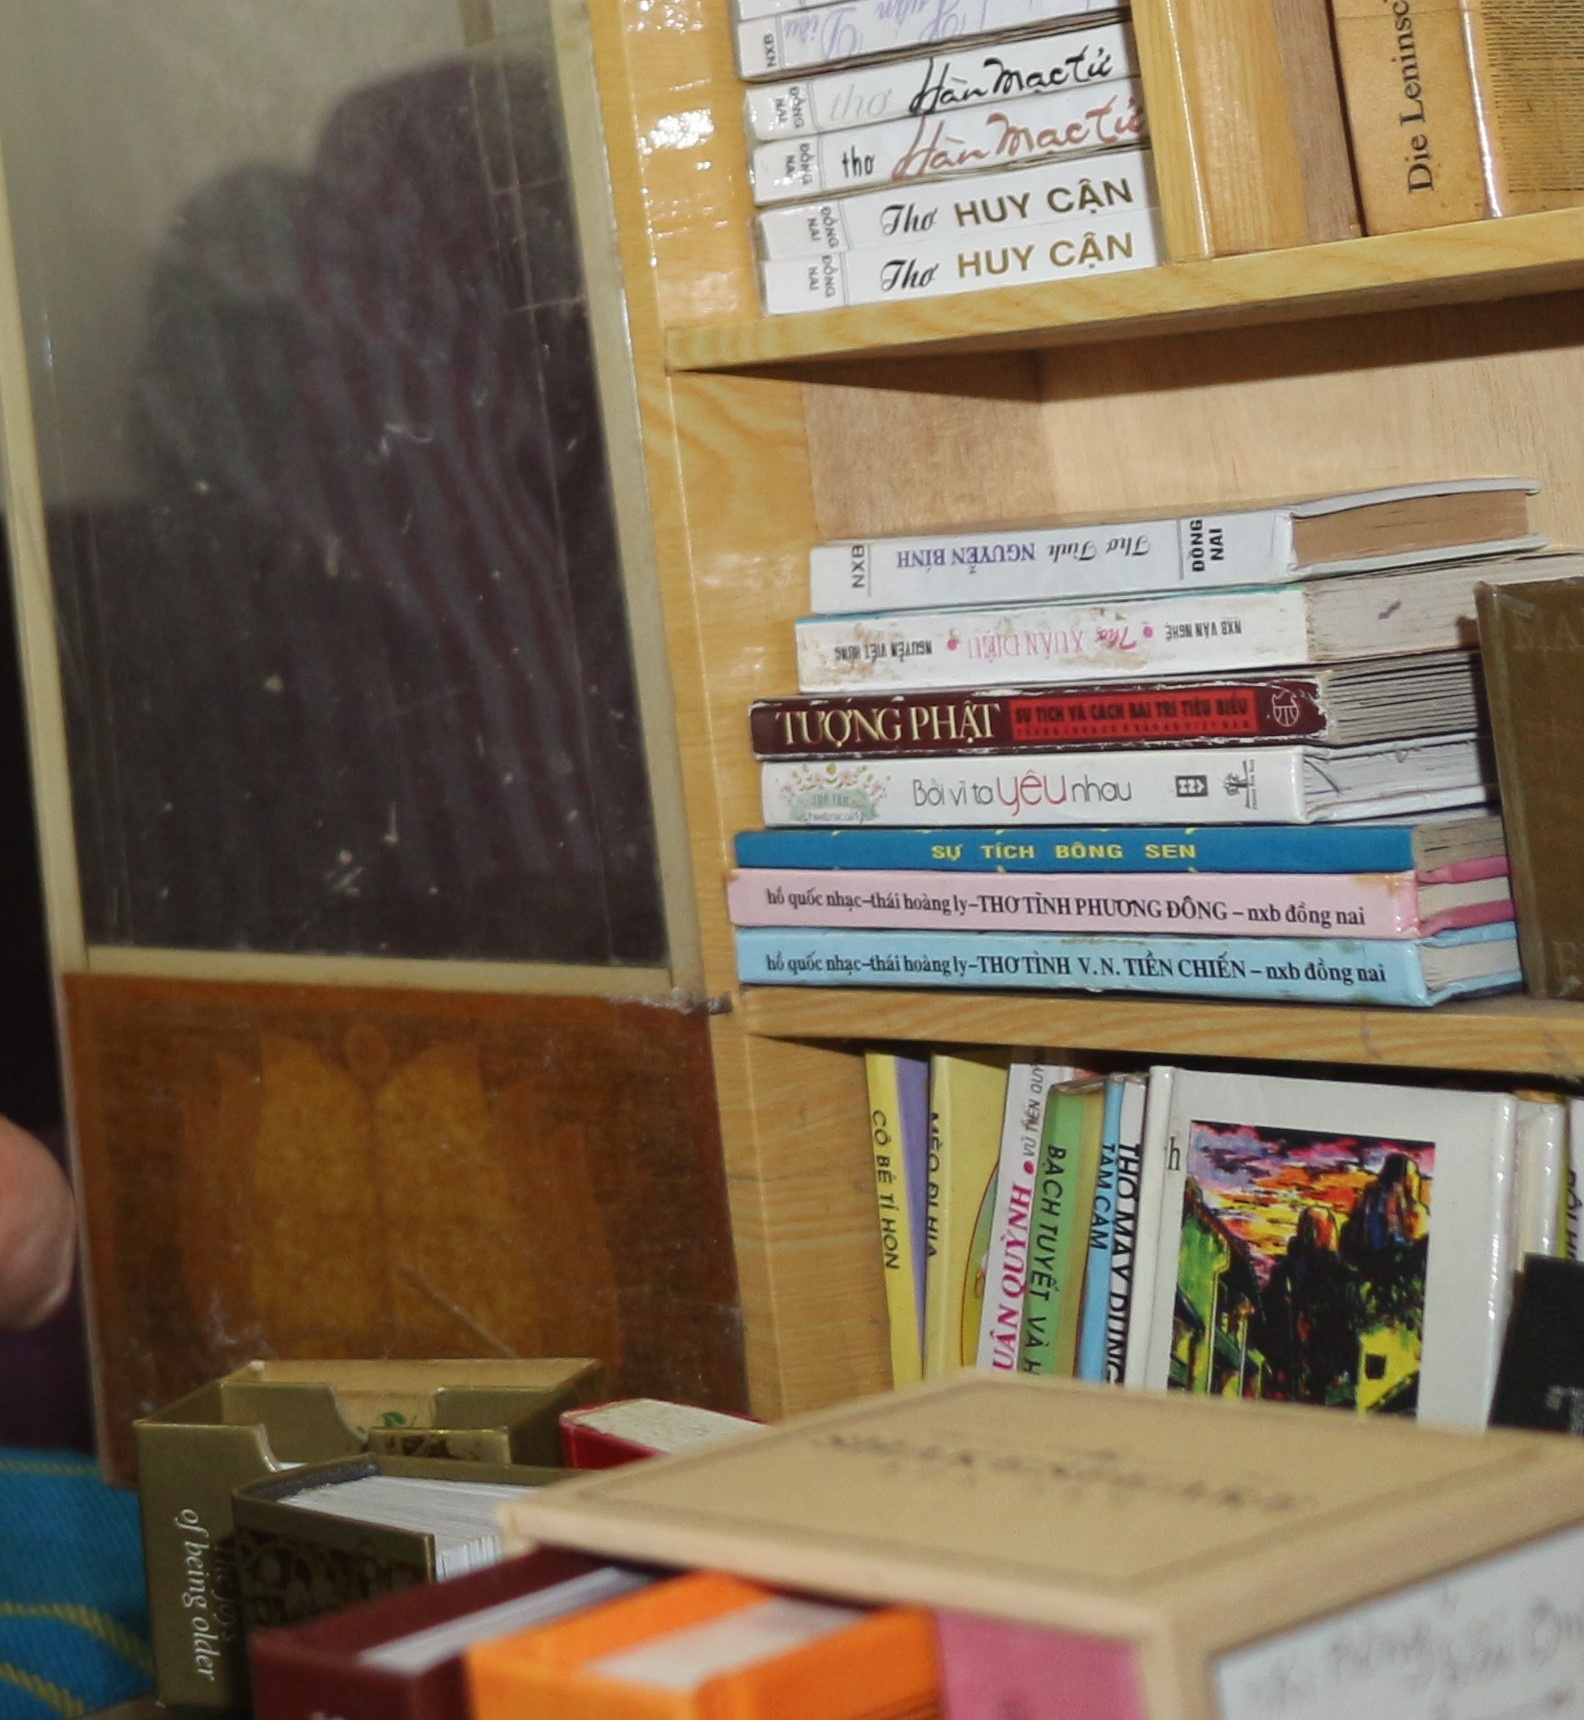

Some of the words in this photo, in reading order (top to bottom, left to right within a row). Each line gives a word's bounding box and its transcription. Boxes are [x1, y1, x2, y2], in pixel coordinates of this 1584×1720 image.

[764, 33, 778, 68] NXB
[841, 144, 876, 180] thơ
[1409, 139, 1435, 195] Die
[806, 216, 820, 242] NAI
[880, 203, 939, 237] Thơ
[954, 192, 1031, 227] HUY
[1046, 177, 1134, 215] CẬN
[806, 266, 820, 292] NAI
[880, 258, 939, 293] Thơ
[956, 244, 1036, 280] HUY
[1048, 231, 1134, 270] CẬN
[851, 543, 867, 589] NXB
[895, 546, 948, 576] BÍNH
[950, 542, 1037, 575] NGUYỄN
[1187, 518, 1206, 573] ĐỒNG
[1208, 526, 1224, 562] NAI
[1221, 619, 1242, 636] NXB
[775, 707, 904, 748] TƯỢNG
[909, 700, 1001, 745] PHẬT
[913, 778, 947, 809] Bởi
[949, 778, 970, 806] vì
[972, 783, 995, 806] ta
[996, 767, 1069, 818] yêu
[1070, 776, 1134, 804] nhau
[931, 843, 964, 861] SỰ
[980, 841, 1036, 859] TÍCH
[1055, 840, 1125, 860] BÔNG
[1144, 843, 1198, 860] SEN
[766, 885, 785, 905] hồ
[788, 886, 824, 910] quốc
[904, 892, 951, 915] hoàng
[1022, 891, 1072, 916] TÌNH
[1075, 897, 1163, 919] PHƯƠNG
[1165, 894, 1228, 921] ĐÔNG
[1247, 902, 1282, 923] nxb
[1285, 899, 1332, 929] đồng
[1335, 905, 1366, 926] nai
[766, 950, 785, 971] hồ
[788, 950, 824, 975] quốc
[904, 955, 951, 977] hoàng
[1021, 949, 1071, 975] TÌNH
[1123, 949, 1174, 978] TIỀN
[1177, 951, 1247, 980] CHIẾN
[1265, 961, 1301, 981] nxb
[1304, 957, 1354, 987] đồng
[1356, 963, 1388, 983] nai
[872, 1110, 891, 1148] CÔ
[875, 1155, 898, 1185] BÉ
[1040, 1144, 1068, 1216] BẠCH
[879, 1191, 900, 1212] TÍ
[880, 1217, 901, 1270] HON
[1000, 1183, 1034, 1298] QUỲNH
[1029, 1221, 1062, 1303] TUYẾT
[1110, 1205, 1138, 1284] MAY
[990, 1303, 1019, 1372] UÂN
[1025, 1316, 1052, 1351] VÀ
[175, 1507, 210, 1540] of
[182, 1536, 210, 1610] being
[191, 1614, 221, 1682] older
